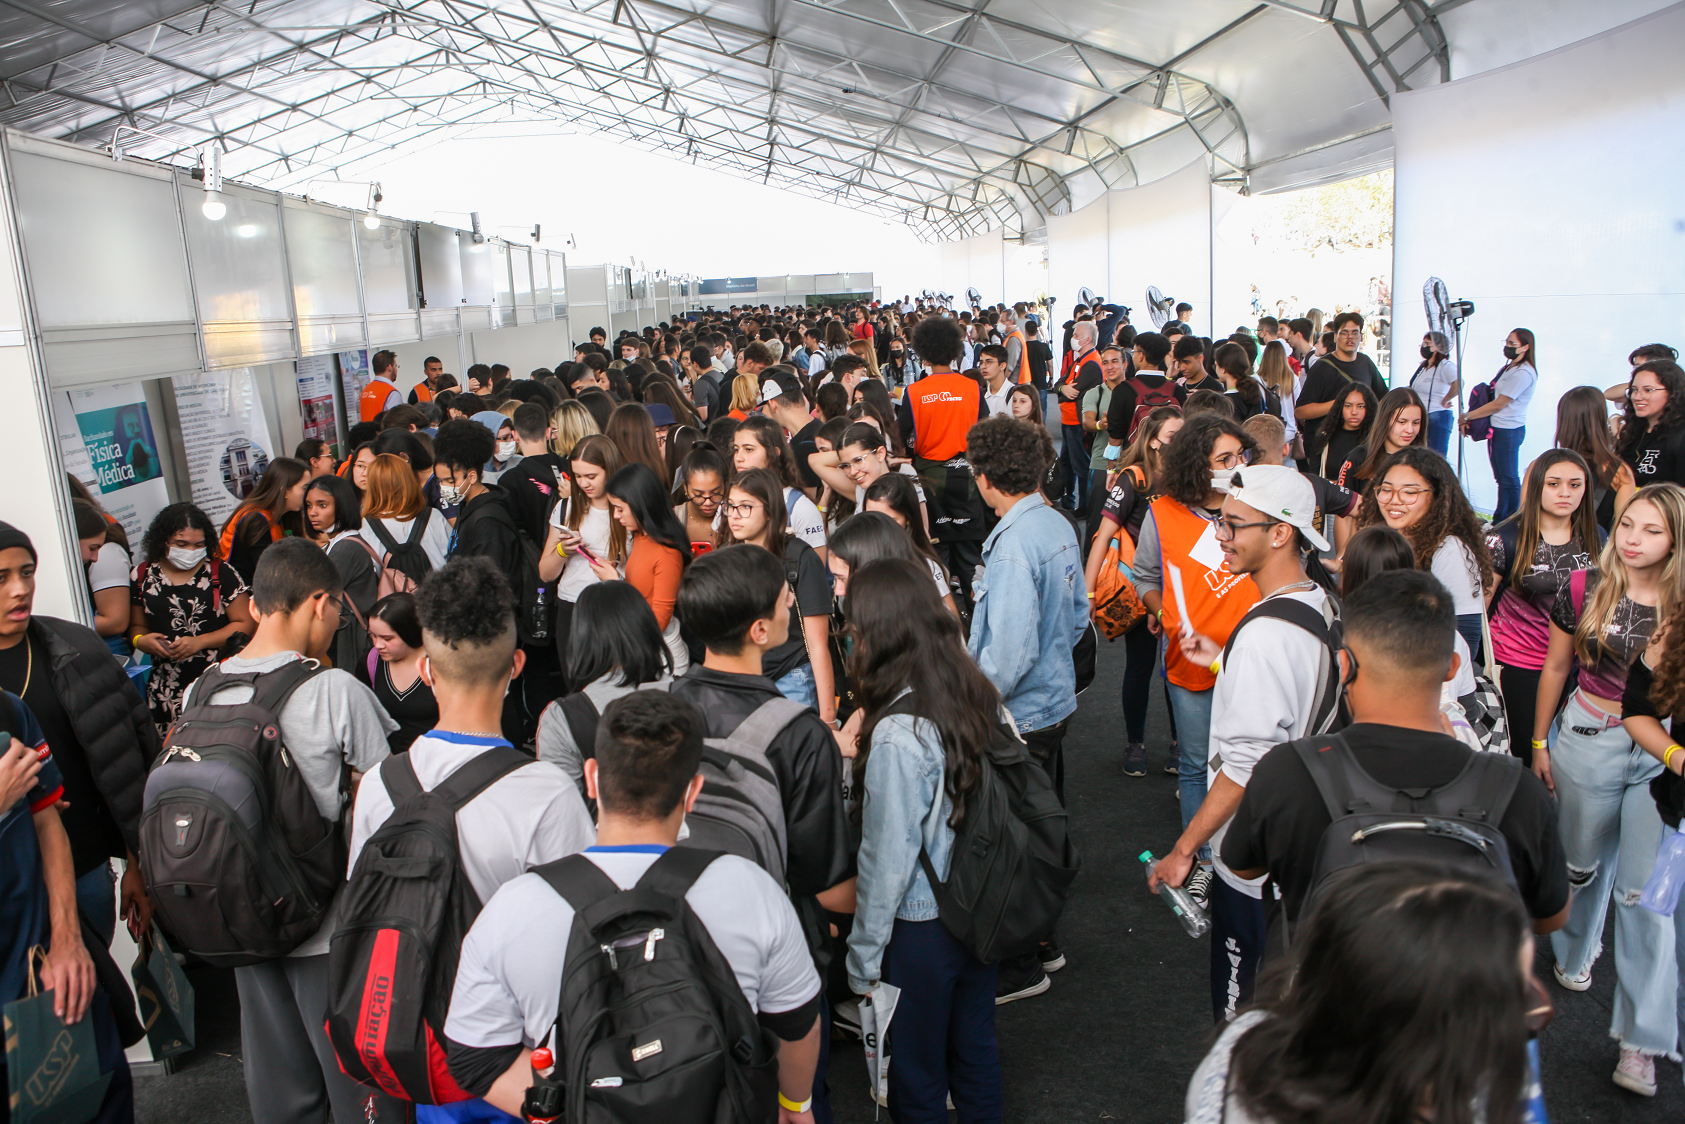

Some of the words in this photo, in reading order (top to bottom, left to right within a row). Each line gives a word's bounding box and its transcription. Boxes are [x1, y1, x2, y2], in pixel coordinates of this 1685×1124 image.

[921, 394, 938, 404] USP
[86, 441, 123, 464] Física
[94, 462, 136, 486] Médica
[25, 1029, 73, 1106] USP
